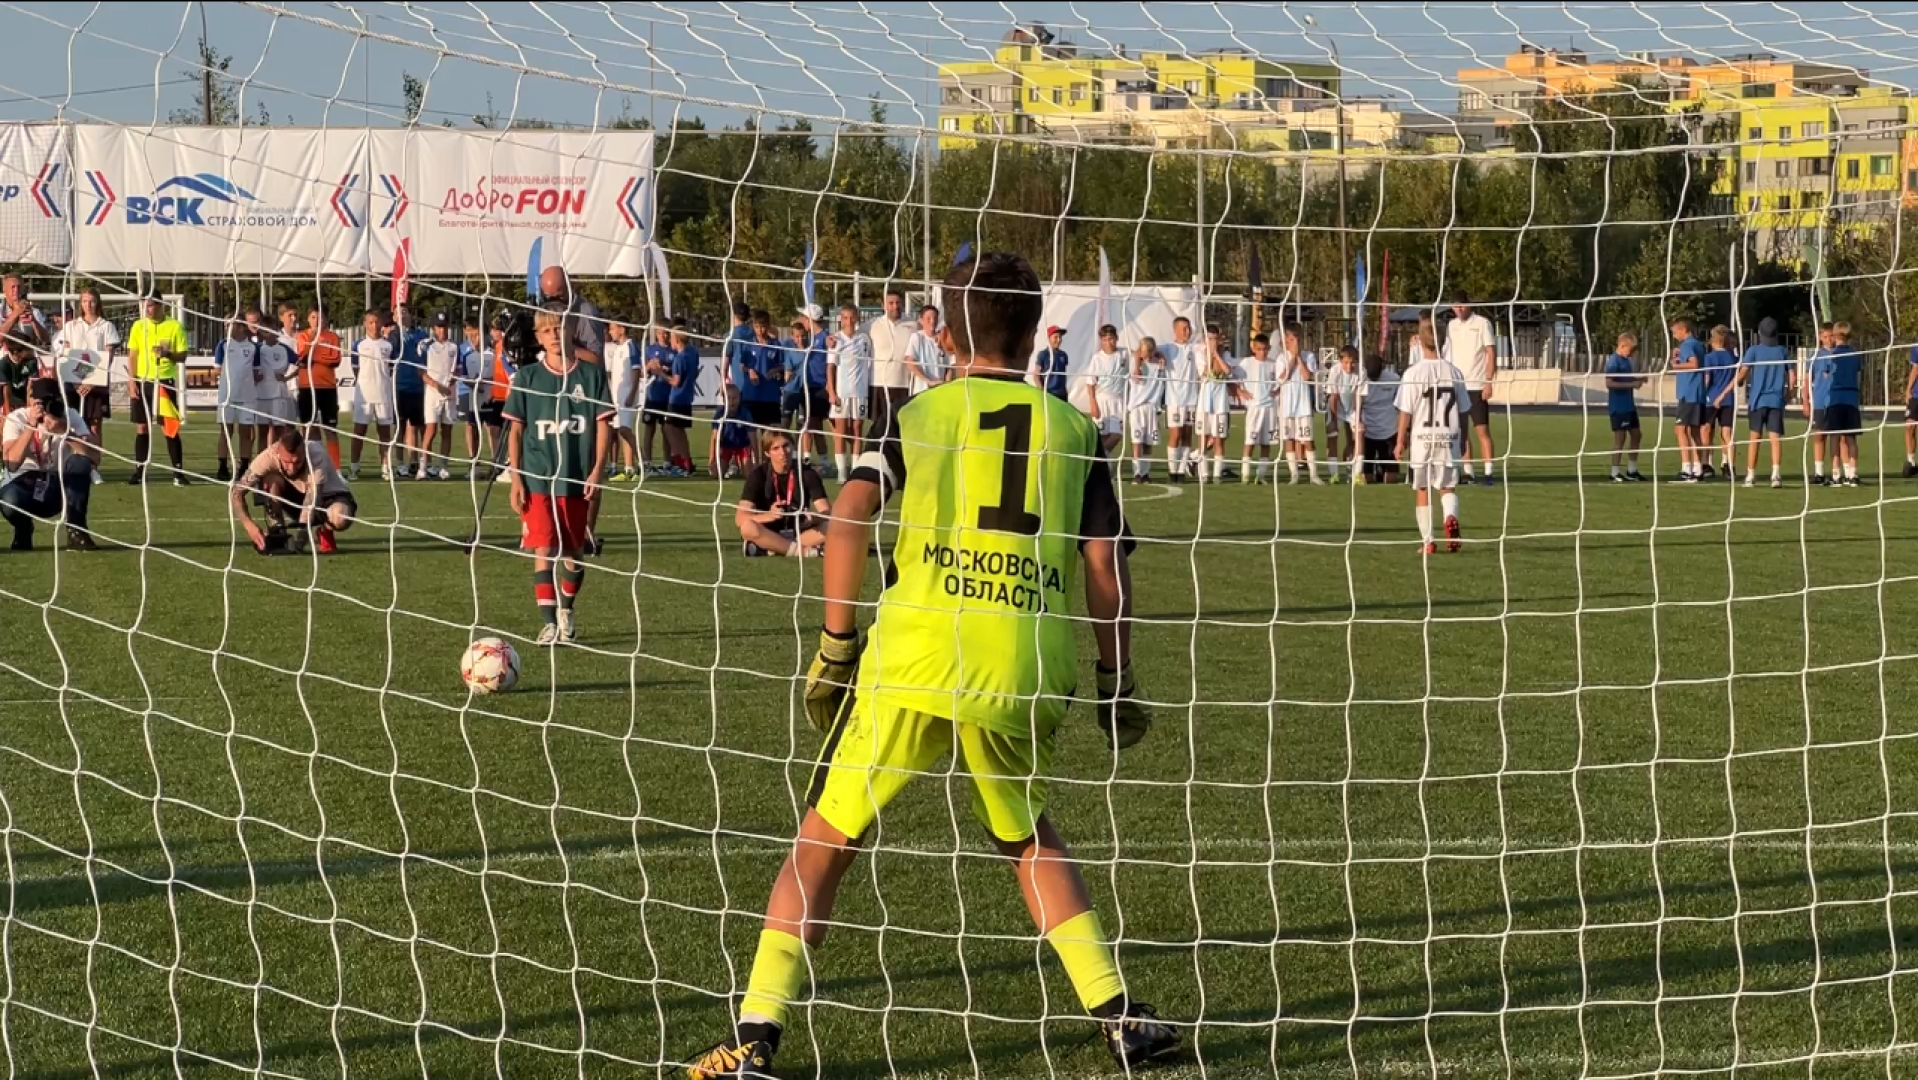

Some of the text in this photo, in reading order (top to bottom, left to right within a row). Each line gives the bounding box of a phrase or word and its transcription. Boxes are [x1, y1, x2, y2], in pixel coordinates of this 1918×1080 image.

[126, 196, 206, 226] ВСК
[207, 214, 286, 227] СТРАХОВОЙ
[438, 219, 588, 230] Благотврительная програма
[1422, 386, 1456, 427] 17
[976, 402, 1041, 535] 1
[943, 574, 1048, 613] ОБЛАСТЬ
